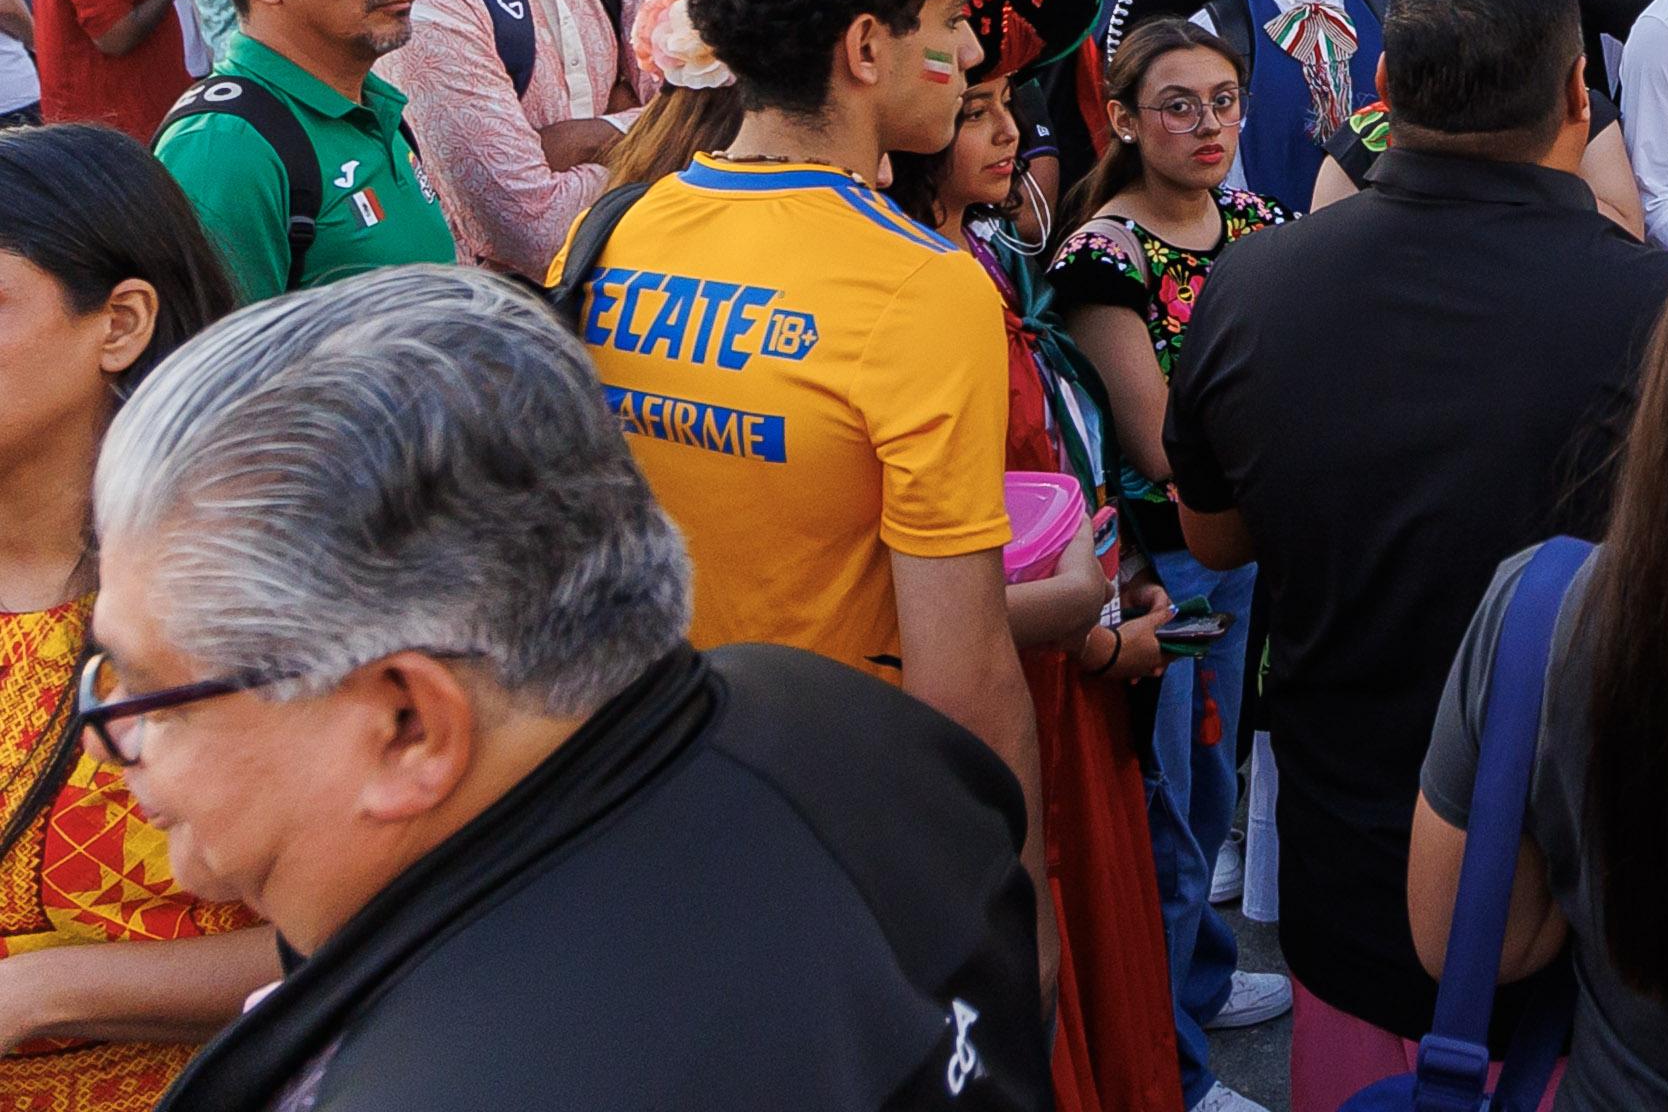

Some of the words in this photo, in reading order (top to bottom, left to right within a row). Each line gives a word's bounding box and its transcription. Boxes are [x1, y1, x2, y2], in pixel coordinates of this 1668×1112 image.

[584, 267, 778, 371] ECATE
[767, 313, 818, 355] 18+
[616, 390, 766, 462] AFIRME
